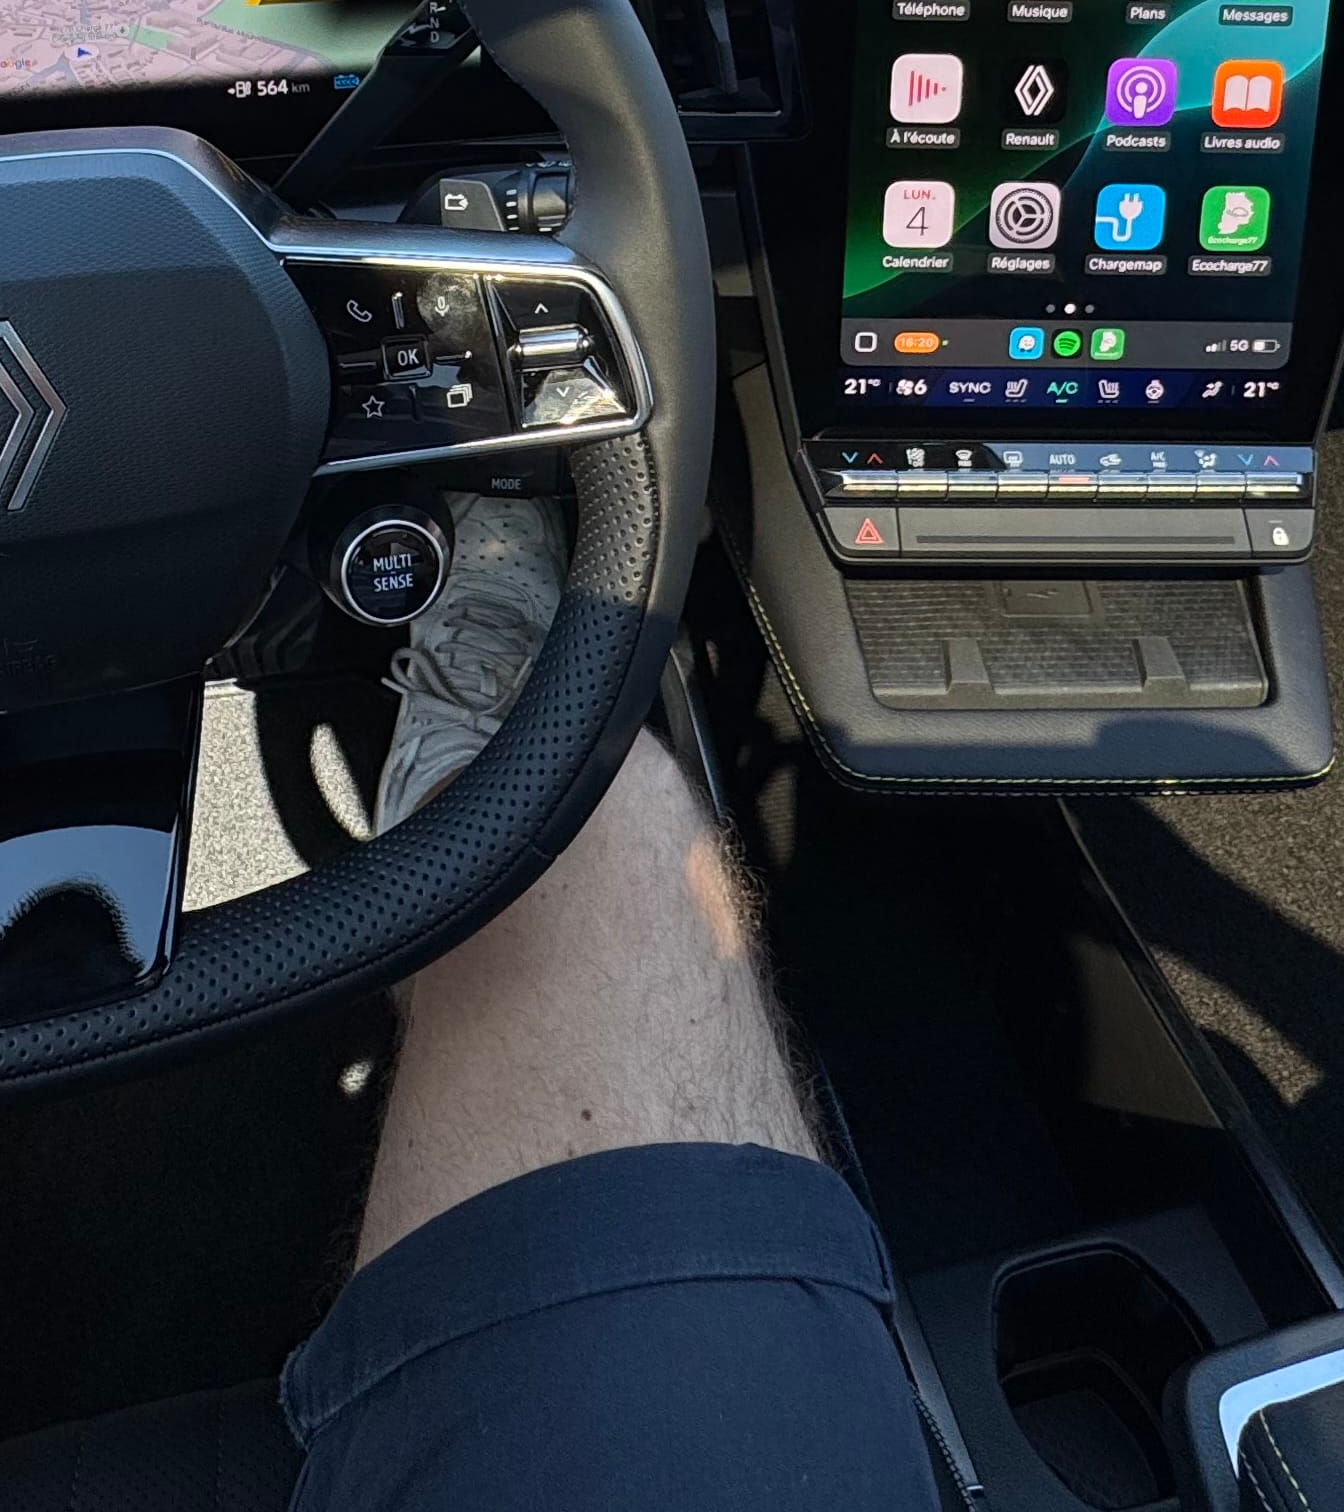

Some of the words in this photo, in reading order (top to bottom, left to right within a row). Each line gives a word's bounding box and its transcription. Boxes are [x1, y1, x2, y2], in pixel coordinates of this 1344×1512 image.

[897, 1, 966, 18] Téléphone
[1011, 4, 1069, 19] Musique
[1130, 7, 1166, 20] Plans
[1222, 9, 1289, 23] Messages
[256, 80, 289, 96] 564
[291, 82, 311, 94] km
[890, 129, 901, 144] À
[1005, 133, 1055, 146] Renault
[1106, 135, 1167, 148] Podcasts
[1204, 137, 1244, 150] Livres
[1244, 138, 1281, 150] audio
[903, 189, 936, 200] LUN.
[906, 206, 929, 237] 4
[882, 255, 950, 268] Calendrier
[991, 256, 1051, 271] Réglages
[1088, 258, 1163, 273] Chargemap
[1192, 259, 1269, 273] Ecocharge77
[1229, 339, 1249, 352] 5G
[397, 348, 419, 366] OK
[914, 379, 928, 395] 6
[949, 381, 992, 395] SYNC
[1046, 382, 1079, 396] A/C
[1049, 453, 1076, 465] AUTO
[491, 478, 521, 490] MODE
[373, 553, 412, 572] MULTI
[373, 572, 414, 591] SENSE
